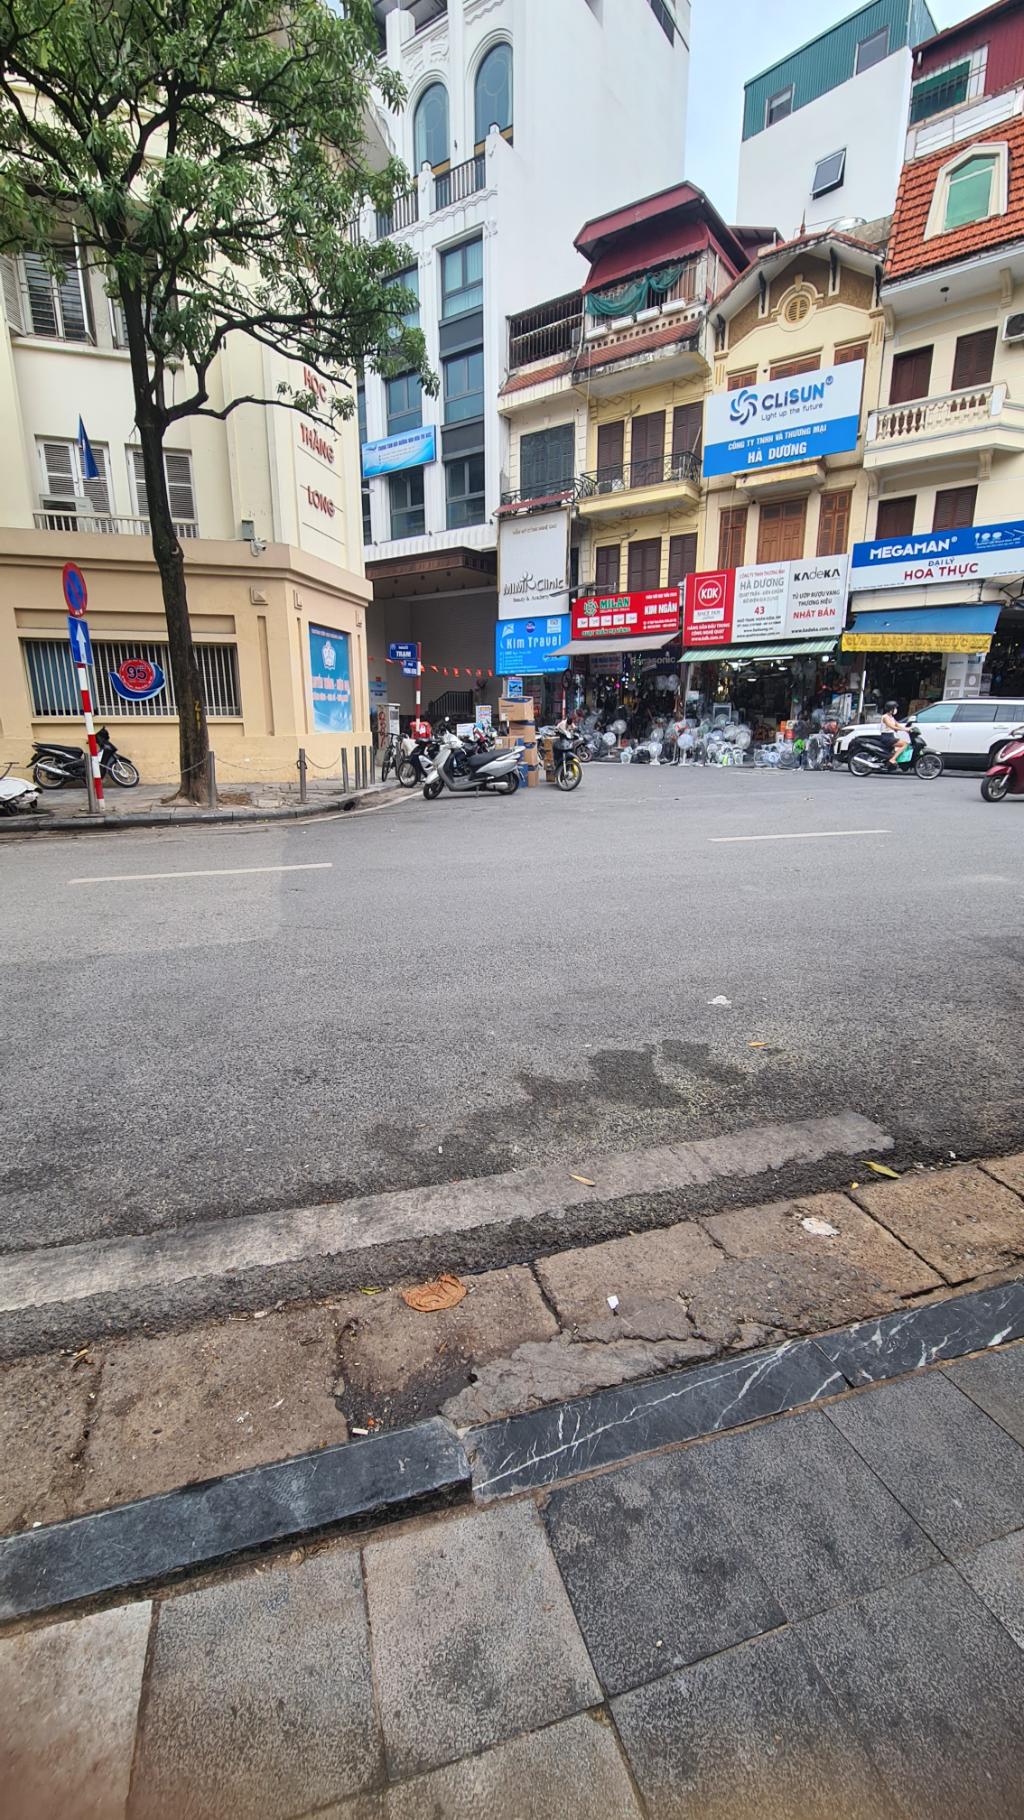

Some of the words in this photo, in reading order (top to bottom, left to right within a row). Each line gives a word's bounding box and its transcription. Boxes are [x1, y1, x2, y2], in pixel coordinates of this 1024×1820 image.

[762, 383, 825, 410] CLISUN
[761, 413, 777, 421] Light
[803, 402, 823, 412] future
[728, 442, 744, 451] CÔNG
[747, 439, 754, 447] TY
[757, 435, 774, 445] TNHH
[775, 433, 783, 441] VÀ
[785, 426, 811, 438] THƯƠNG
[812, 424, 826, 434] MẠI
[748, 447, 763, 464] HÀ
[768, 441, 807, 461] DƯƠNG
[307, 485, 335, 518] LONG
[869, 539, 950, 560] MEGAMAN
[928, 559, 944, 567] ĐẠI
[945, 557, 955, 565] LÝ
[904, 568, 934, 580] HOA
[938, 563, 979, 578] THỰC
[740, 579, 751, 590] HÀ
[753, 577, 784, 589] DƯƠNG
[701, 588, 719, 600] KDK
[644, 605, 657, 615] KIM
[755, 606, 765, 615] 43
[507, 639, 524, 649] Kim
[127, 666, 146, 679] 95
